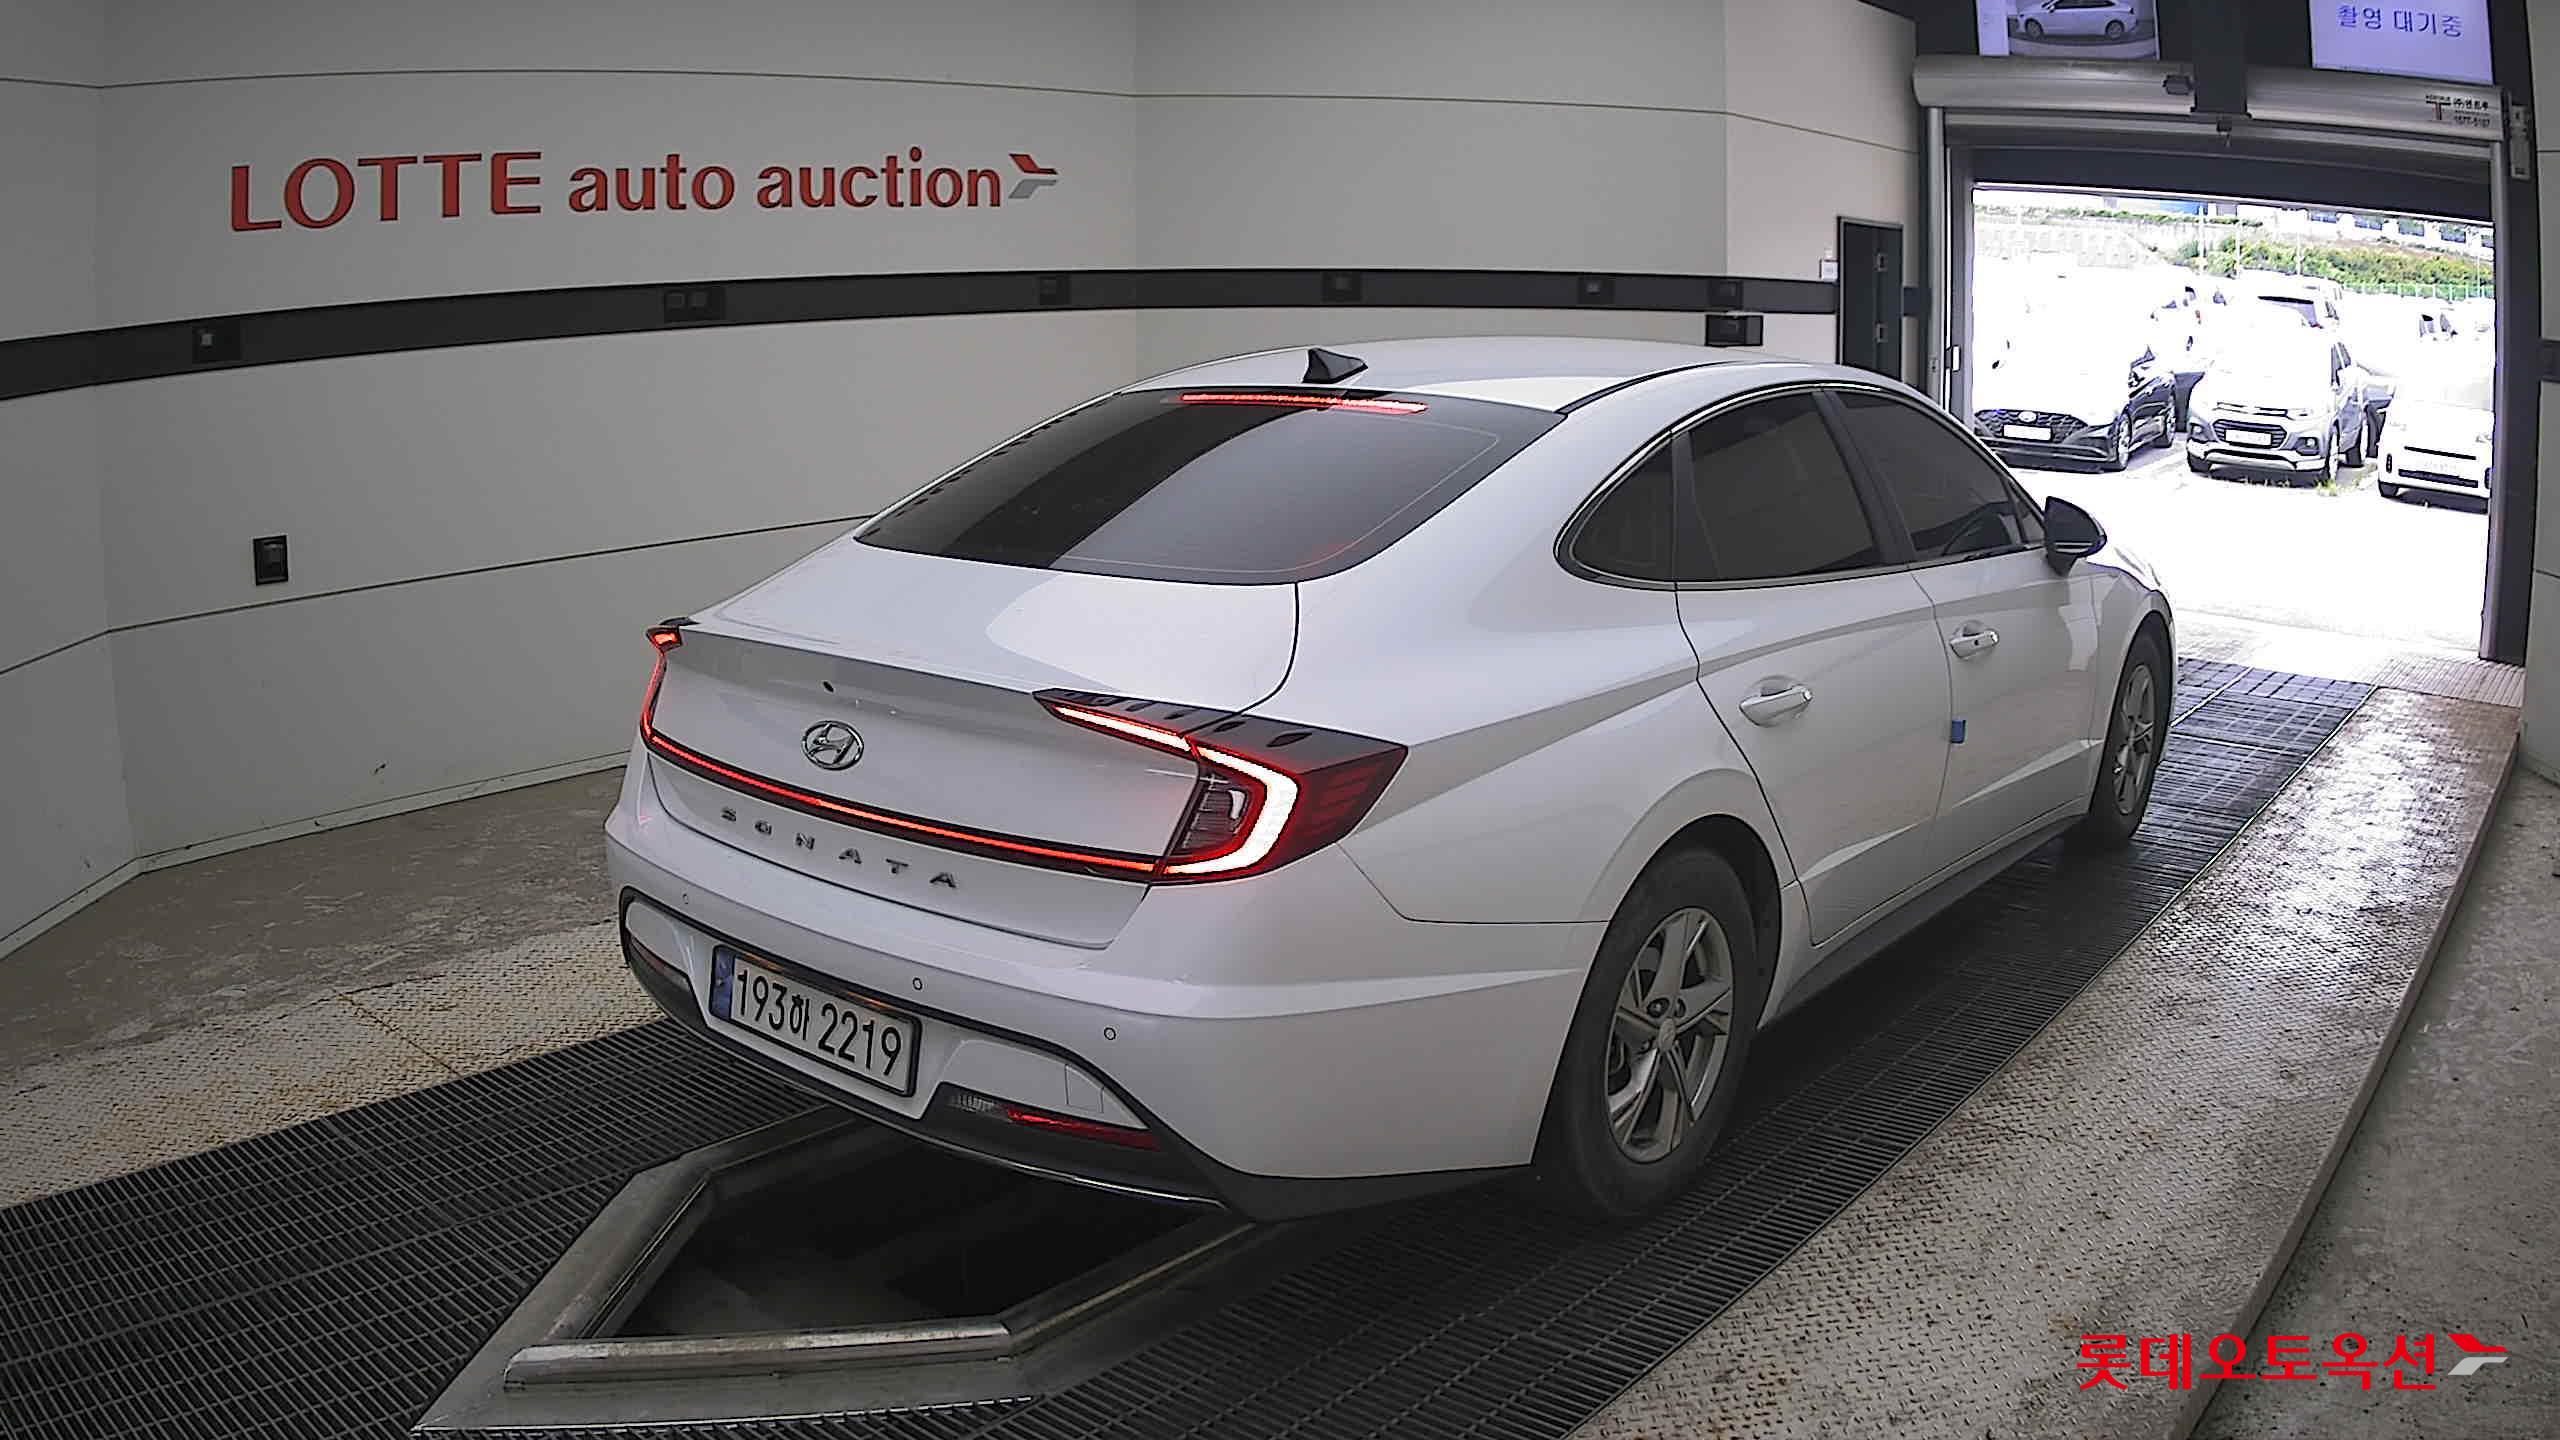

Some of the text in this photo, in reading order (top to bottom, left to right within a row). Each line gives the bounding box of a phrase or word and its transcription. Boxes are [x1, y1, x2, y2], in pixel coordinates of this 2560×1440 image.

[2393, 10, 2461, 37] 대기중
[230, 146, 1001, 232] LOTTE auto auction
[721, 806, 957, 889] SONATA
[737, 969, 902, 1076] 193하 2219
